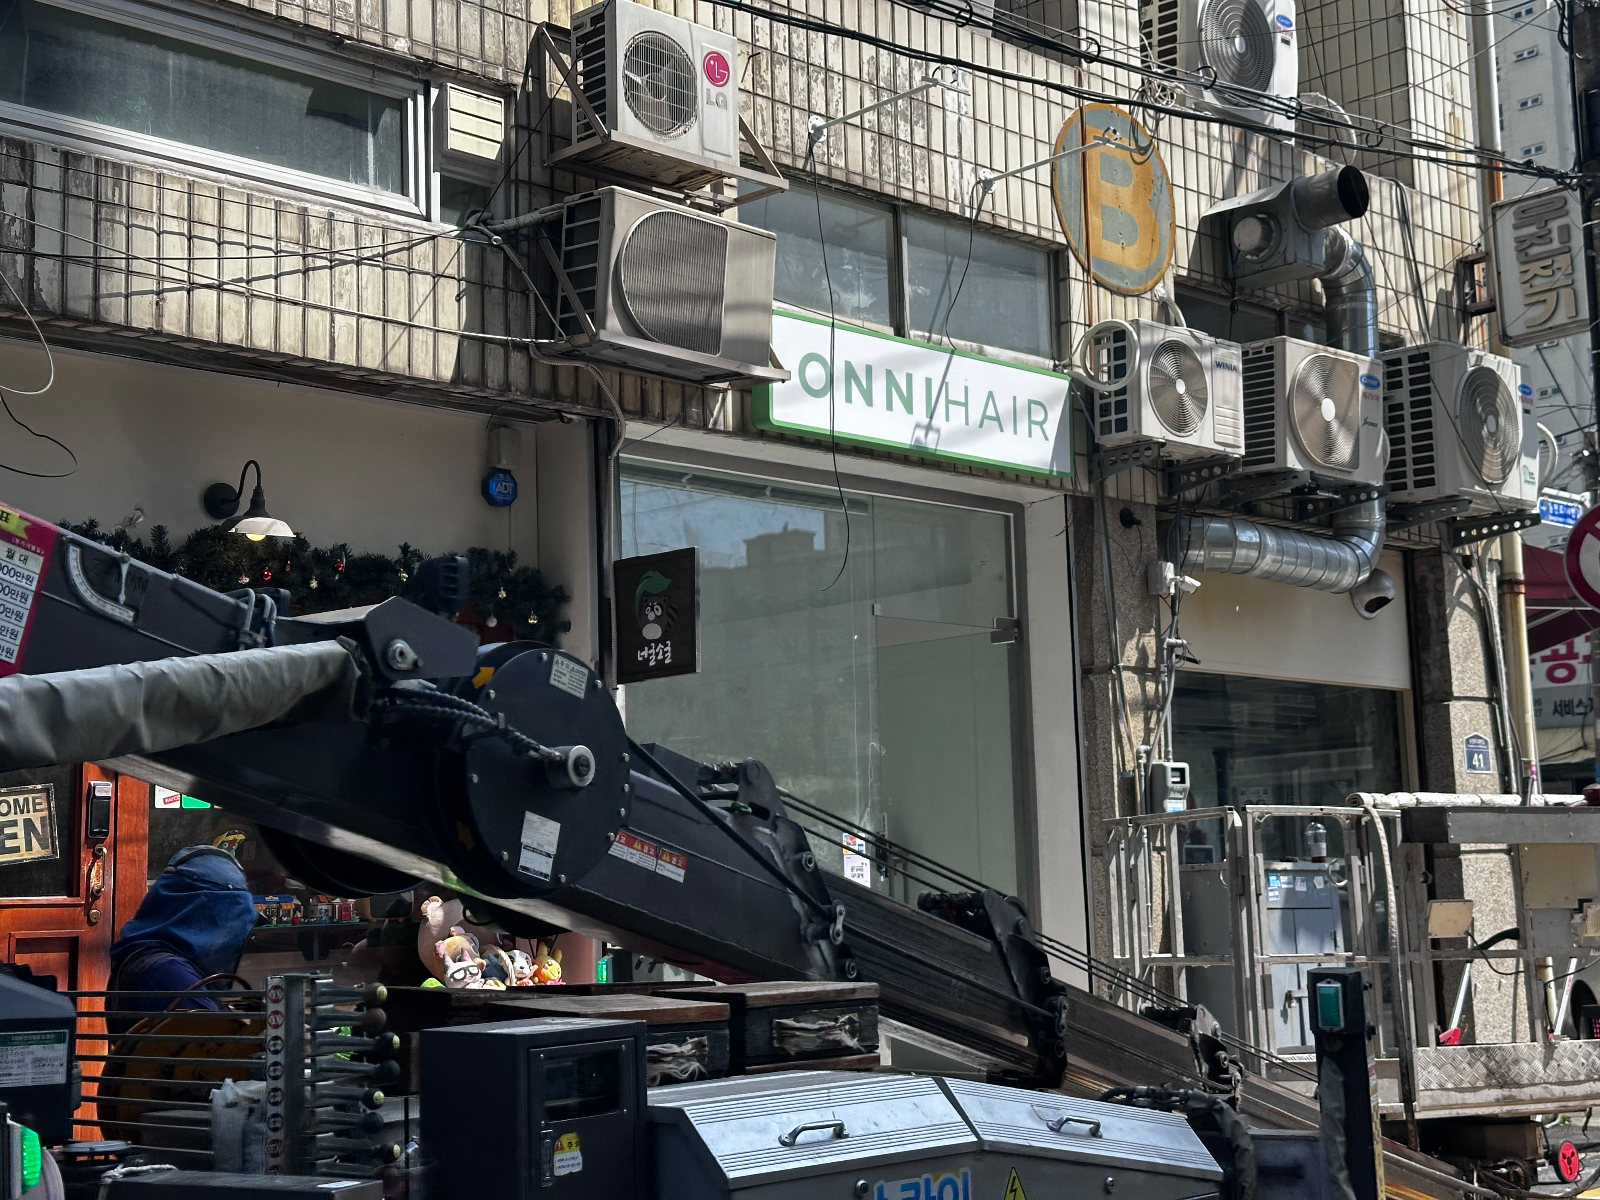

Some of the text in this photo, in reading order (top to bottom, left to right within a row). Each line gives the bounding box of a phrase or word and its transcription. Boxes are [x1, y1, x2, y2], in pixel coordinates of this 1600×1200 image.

[706, 88, 728, 110] LG
[1078, 123, 1160, 270] B
[1512, 195, 1578, 328] 우진전기
[1215, 360, 1238, 373] WINIA
[495, 482, 514, 494] ADT
[637, 640, 672, 667] 너굴소굴
[1472, 753, 1484, 768] 41
[0, 796, 43, 817] OME
[0, 816, 49, 855] EN
